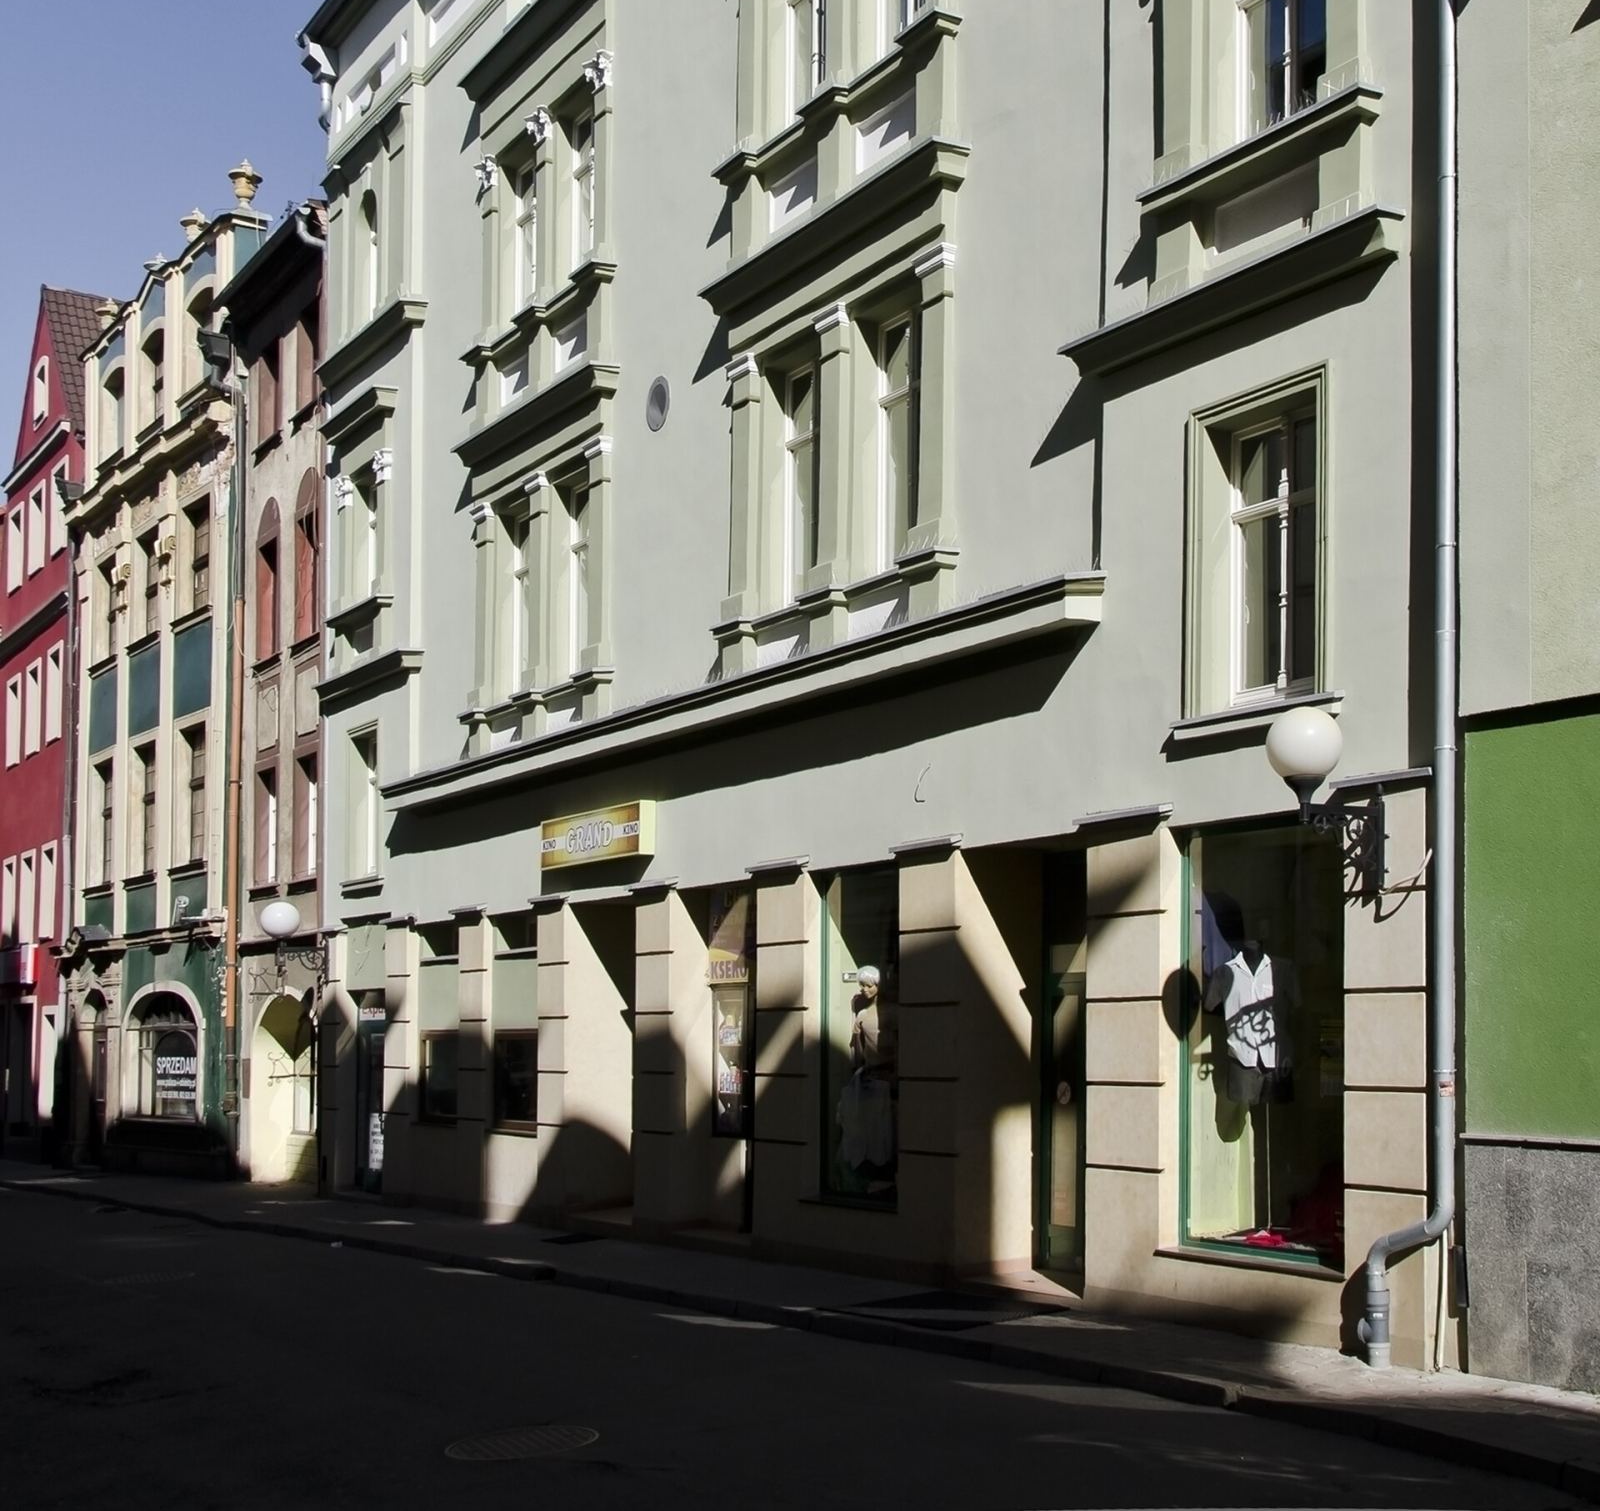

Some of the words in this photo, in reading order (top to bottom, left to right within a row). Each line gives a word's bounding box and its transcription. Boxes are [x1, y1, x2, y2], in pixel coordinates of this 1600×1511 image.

[542, 839, 557, 850] KINO
[566, 821, 614, 854] GRAND
[623, 822, 639, 834] KINO
